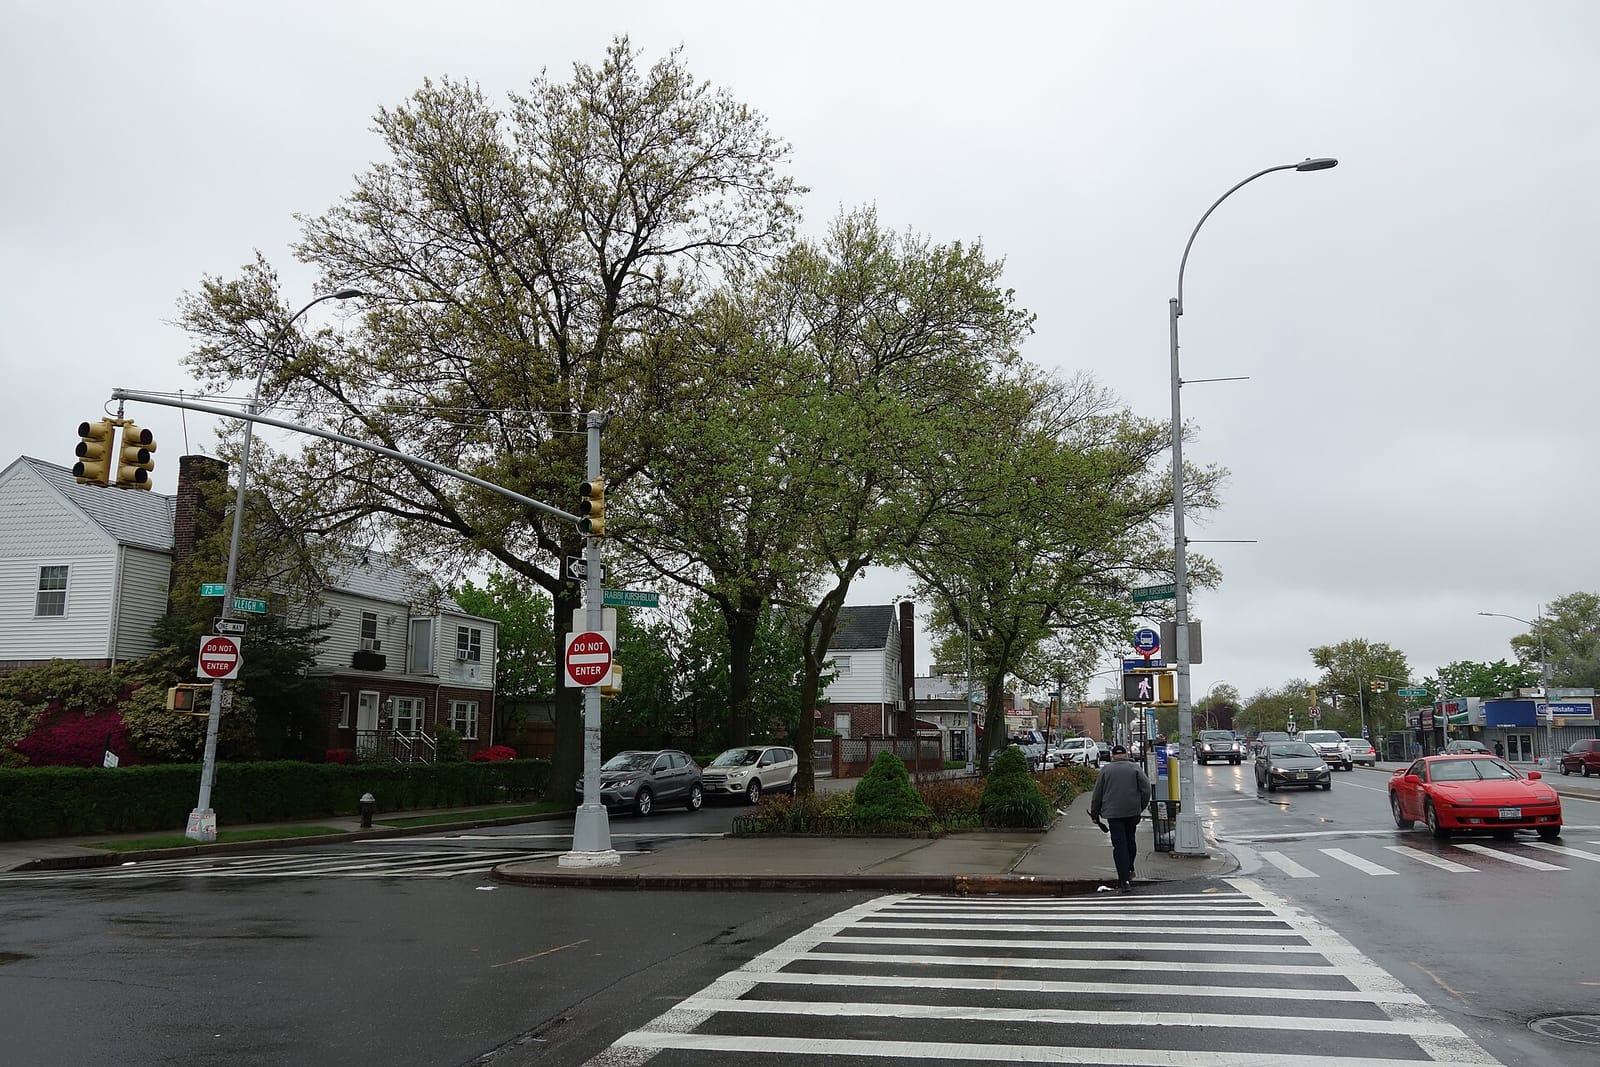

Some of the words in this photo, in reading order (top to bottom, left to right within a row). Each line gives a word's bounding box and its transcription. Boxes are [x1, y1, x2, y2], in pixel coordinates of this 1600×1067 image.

[205, 585, 213, 594] 73
[604, 591, 624, 600] RABBI
[234, 600, 257, 610] VLEIGH
[207, 644, 217, 652] DO
[218, 645, 233, 653] NOT
[574, 642, 585, 652] DO
[587, 641, 604, 652] NOT
[206, 662, 229, 671] ENTER
[575, 666, 602, 676] ENTER
